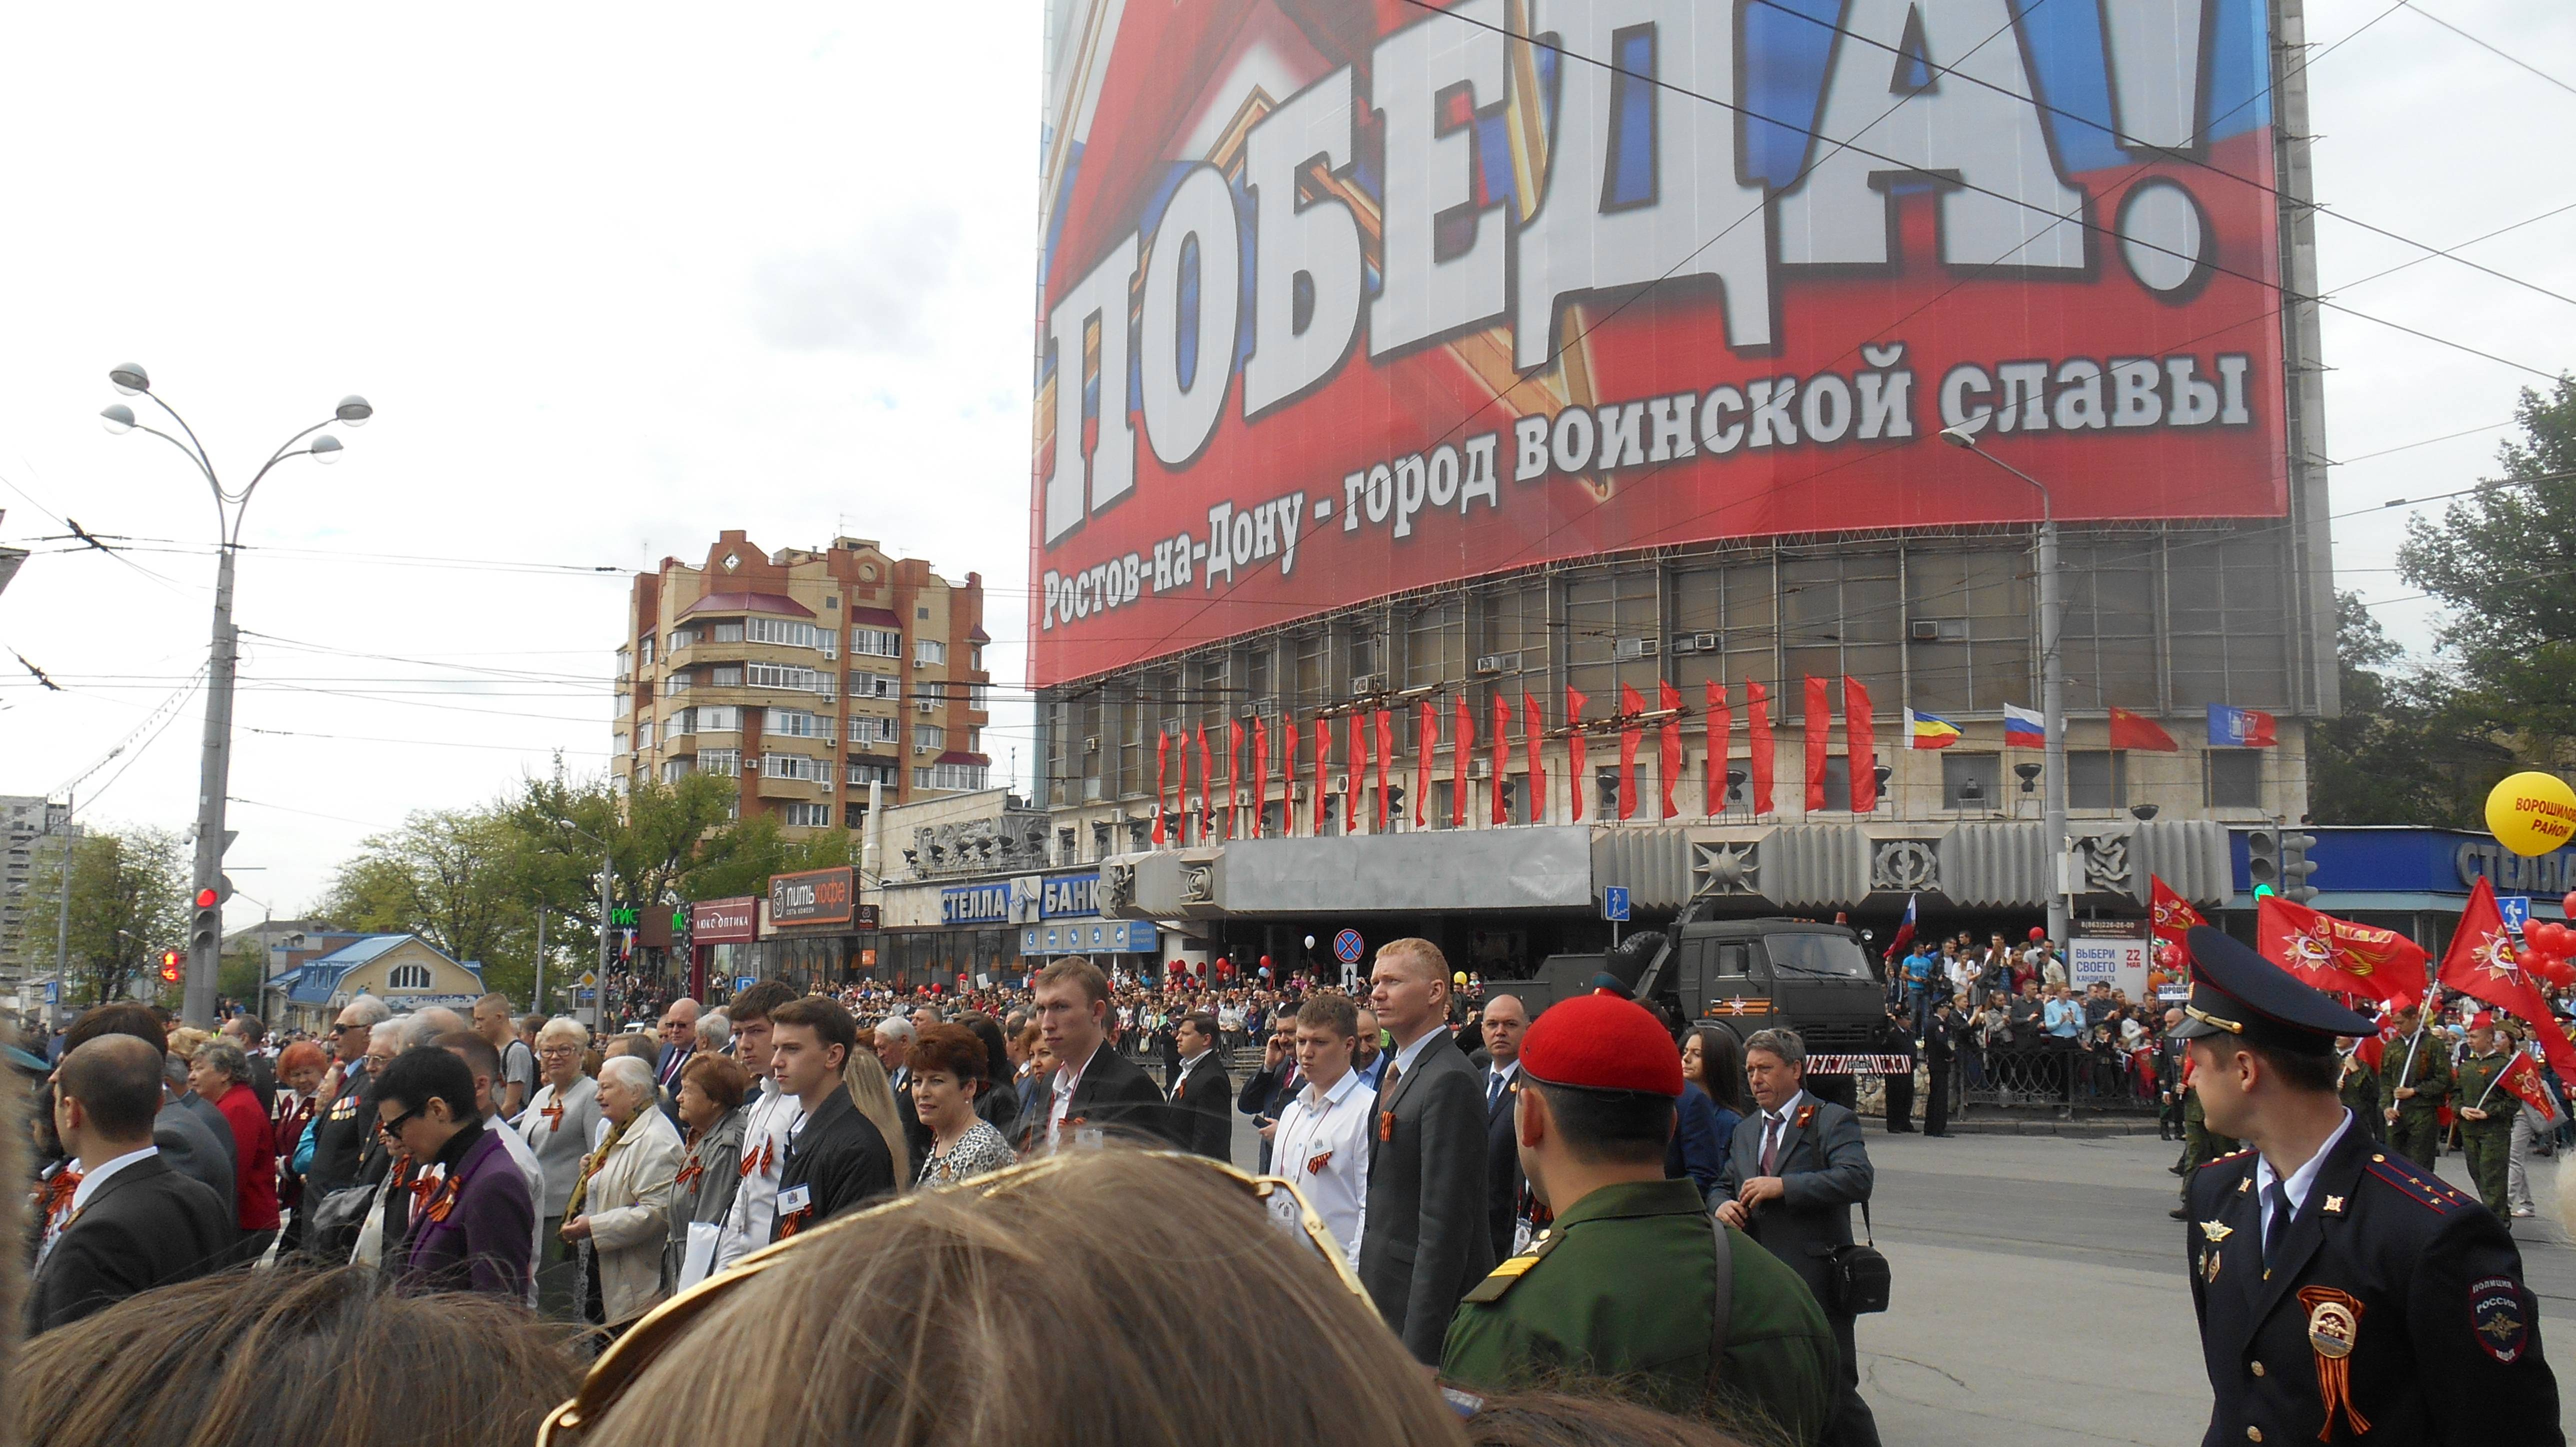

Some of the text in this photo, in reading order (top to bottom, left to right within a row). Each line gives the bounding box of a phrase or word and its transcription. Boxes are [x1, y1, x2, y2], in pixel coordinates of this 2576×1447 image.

[1044, 0, 2212, 545] ПОБЕДА!
[1043, 492, 1303, 630] Ростов-на-Дону
[1344, 438, 1497, 538] город
[1515, 346, 1914, 482] воинской
[1939, 354, 2251, 434] славы
[2531, 819, 2570, 838] РАЙОН
[942, 879, 1100, 920] СТЕЛЛА БАНК
[696, 912, 748, 929] ЛЮКС ОПТИКА
[2076, 948, 2115, 959] ВЫБЕРИ
[2126, 950, 2140, 961] 22
[2076, 962, 2116, 972] СВОЕГО
[2472, 1279, 2512, 1294] ПОЛИЦИЯ
[2476, 1297, 2518, 1313] РОССИЯ
